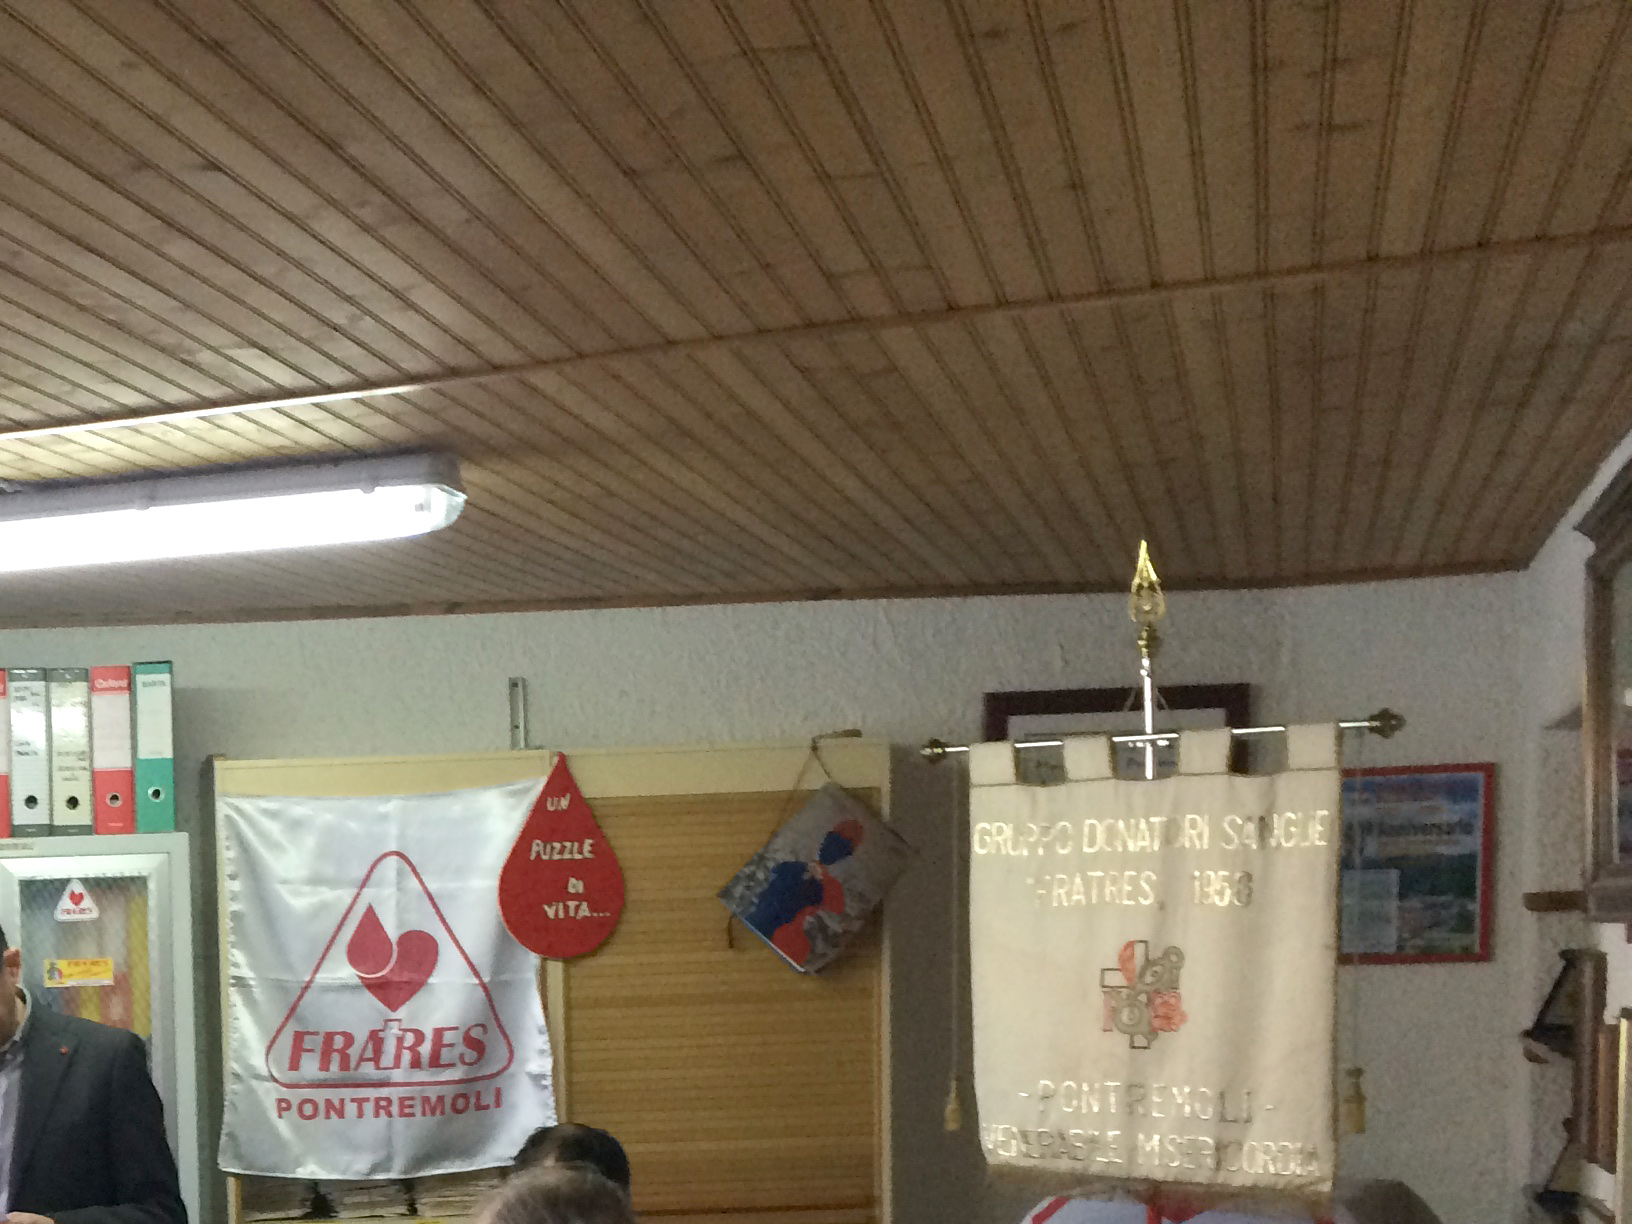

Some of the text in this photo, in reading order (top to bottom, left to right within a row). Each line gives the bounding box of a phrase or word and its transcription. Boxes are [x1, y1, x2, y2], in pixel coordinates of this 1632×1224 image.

[546, 793, 571, 811] UN
[973, 821, 1073, 855] GRUPPO
[1082, 813, 1210, 854] DONATORI
[1221, 810, 1329, 850] SANGUE
[529, 839, 596, 860] PUZZLE
[568, 877, 584, 893] DI
[275, 1087, 502, 1121] PONTREMOLI
